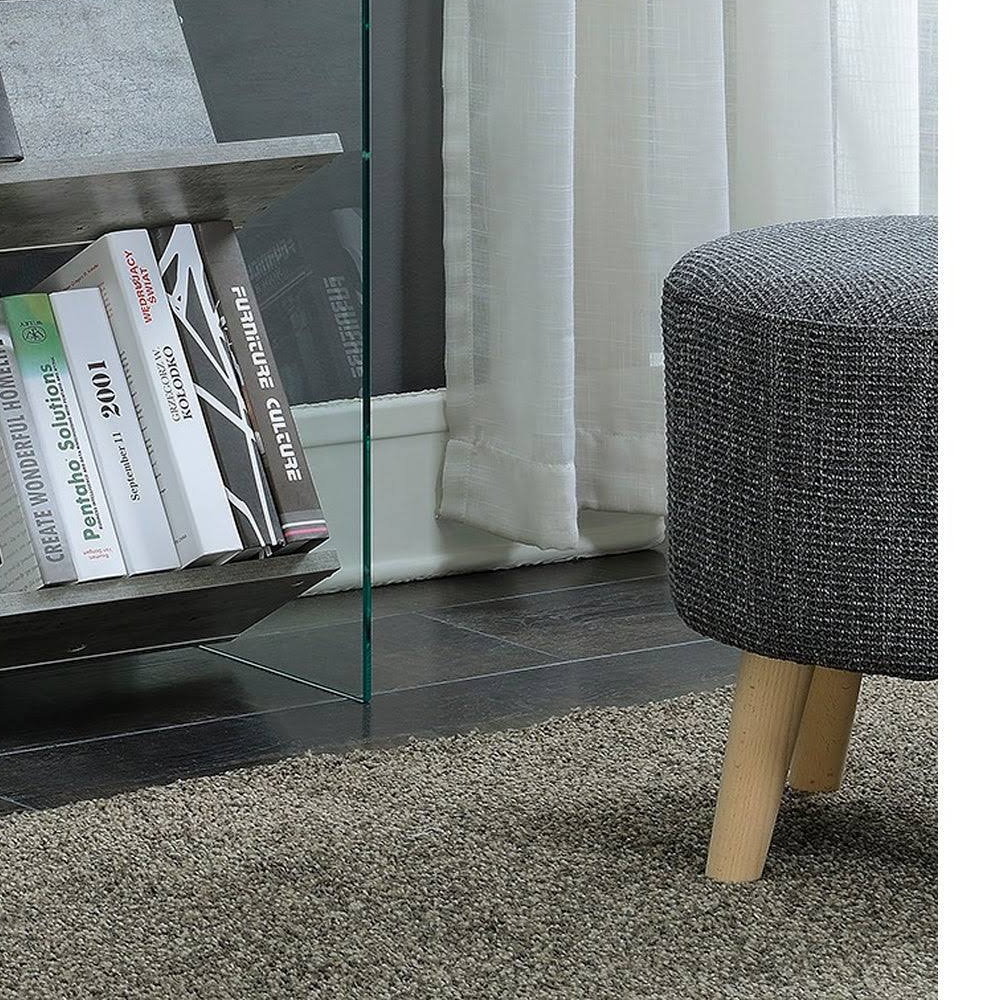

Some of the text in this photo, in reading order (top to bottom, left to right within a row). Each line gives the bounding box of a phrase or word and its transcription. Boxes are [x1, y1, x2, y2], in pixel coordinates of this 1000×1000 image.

[40, 363, 75, 451] Solutions
[87, 360, 121, 419] 2001
[7, 415, 48, 507] WONDERFUL
[112, 432, 124, 444] 11
[266, 397, 302, 482] CULTURE
[68, 459, 101, 541] Pentaho
[119, 445, 141, 502] September
[34, 509, 65, 562] CREATE
